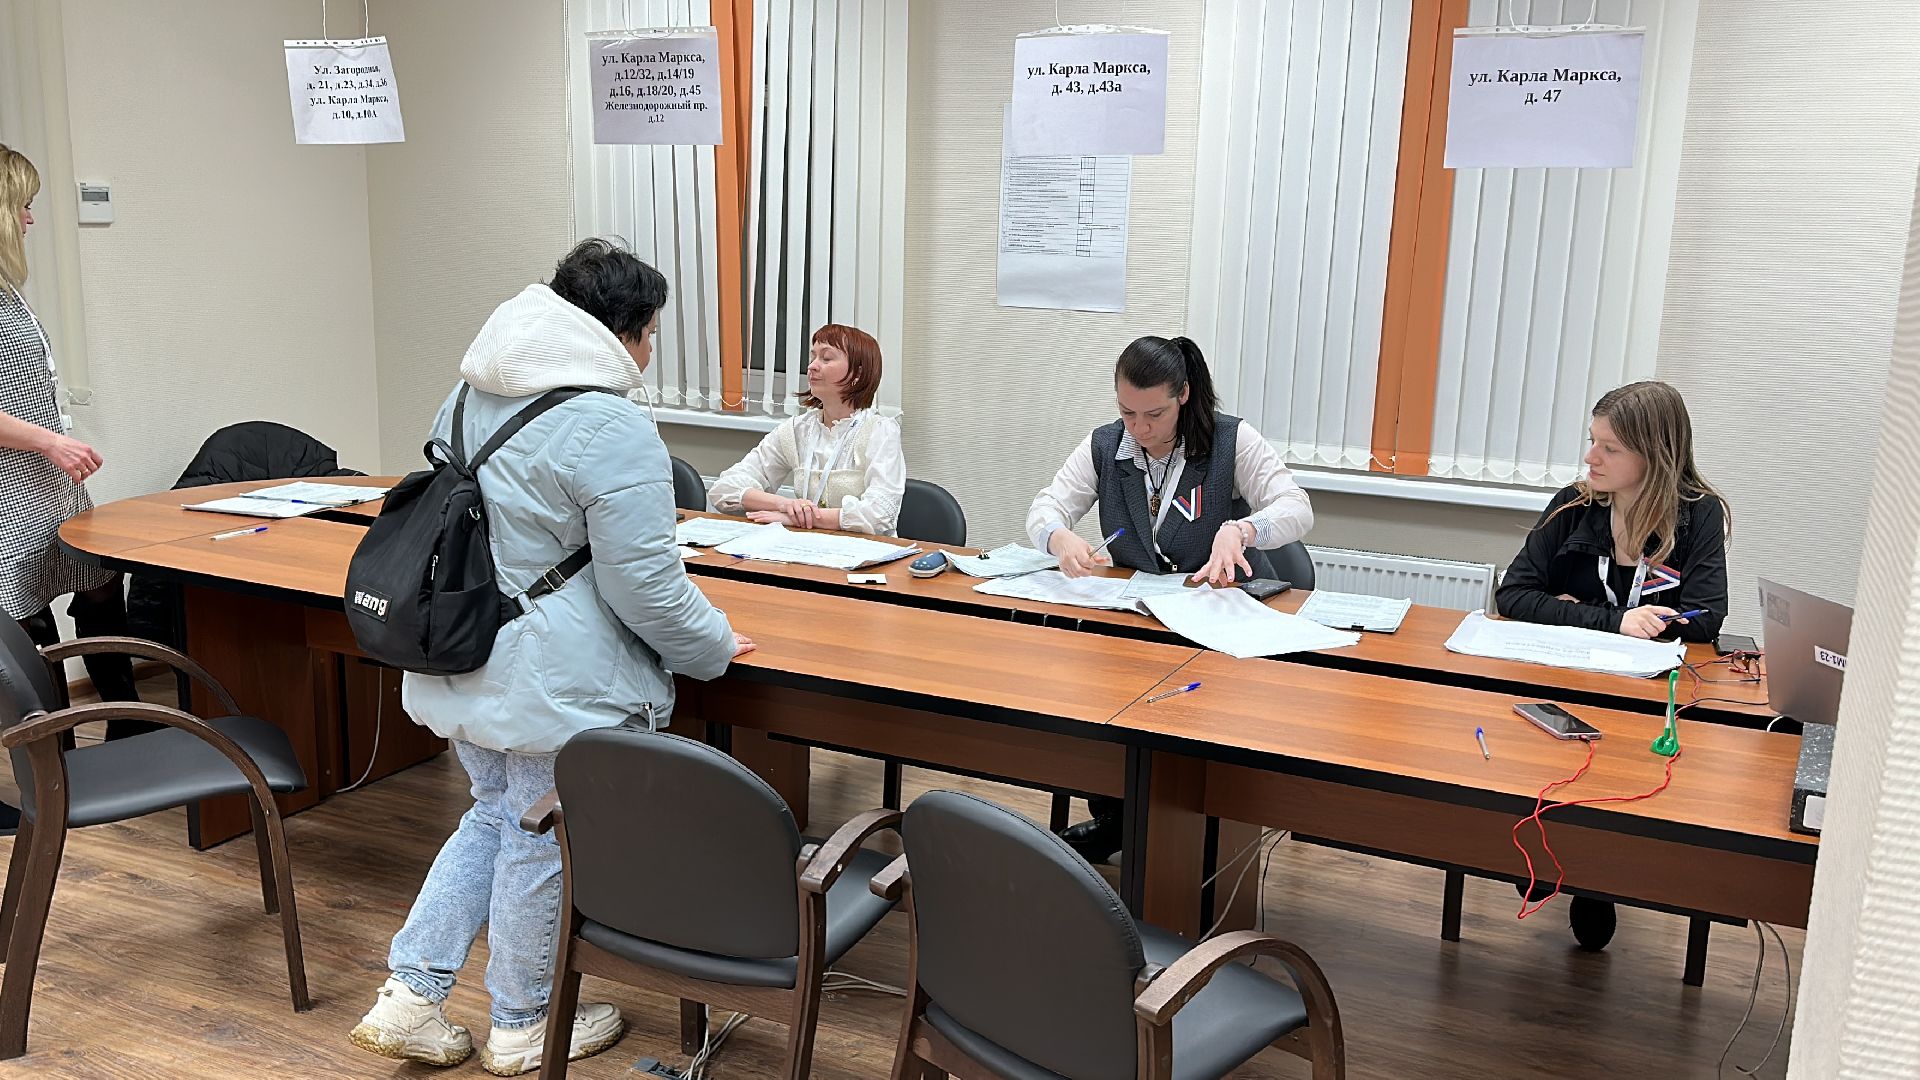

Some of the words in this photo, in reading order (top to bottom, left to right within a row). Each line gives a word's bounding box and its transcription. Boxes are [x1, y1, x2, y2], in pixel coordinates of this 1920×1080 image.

[602, 55, 619, 67] ул.
[621, 52, 656, 66] Карла
[658, 51, 706, 66] Маркса,
[314, 65, 332, 75] Ул.
[614, 68, 655, 82] д.12/32,
[657, 68, 695, 81] д.14/19
[1027, 67, 1046, 80] ул.
[1048, 62, 1090, 78] Карла
[1093, 61, 1151, 78] Маркса,
[1468, 72, 1493, 87] ул.
[1496, 69, 1549, 86] Карла
[1552, 68, 1622, 85] Маркса,
[306, 82, 316, 90] д.
[318, 80, 333, 91] 21,
[335, 80, 357, 91] д.23,
[609, 85, 634, 98] д.16,
[636, 85, 677, 98] д.18/20,
[679, 84, 701, 98] д.45
[1051, 84, 1063, 97] д.
[1065, 81, 1085, 95] 43,
[1087, 80, 1123, 96] д.43а
[310, 96, 326, 107] ул.
[328, 95, 358, 106] Карла
[361, 94, 389, 106] Маркса,
[1524, 91, 1539, 105] д.
[1542, 89, 1563, 103] 47
[605, 100, 691, 112] Железнодорожный
[693, 101, 708, 112] пр.
[332, 110, 355, 120] д.10,
[648, 114, 665, 124] д.12
